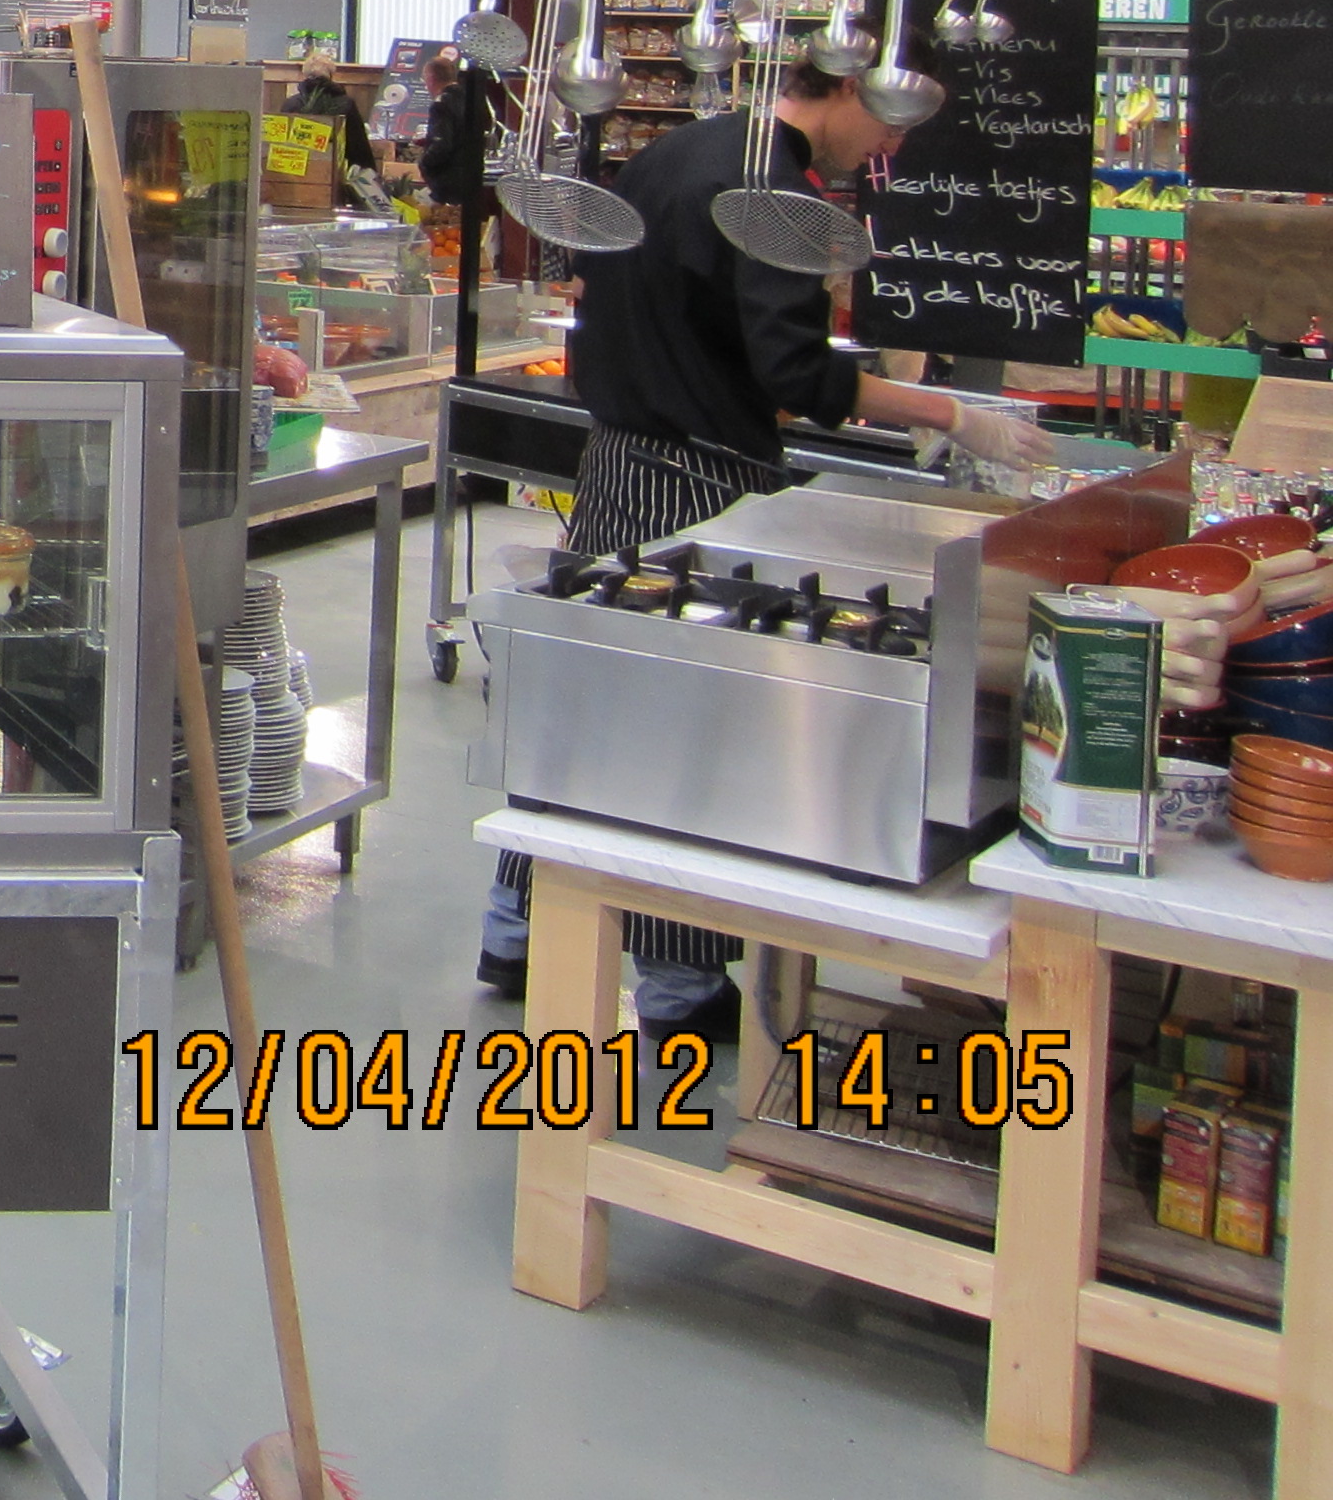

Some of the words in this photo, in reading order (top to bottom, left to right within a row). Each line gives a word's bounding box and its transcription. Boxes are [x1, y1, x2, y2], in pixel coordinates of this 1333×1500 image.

[988, 168, 1077, 223] toetjes
[864, 214, 1004, 268] Lekkers
[1016, 255, 1082, 273] voor
[923, 280, 971, 304] de
